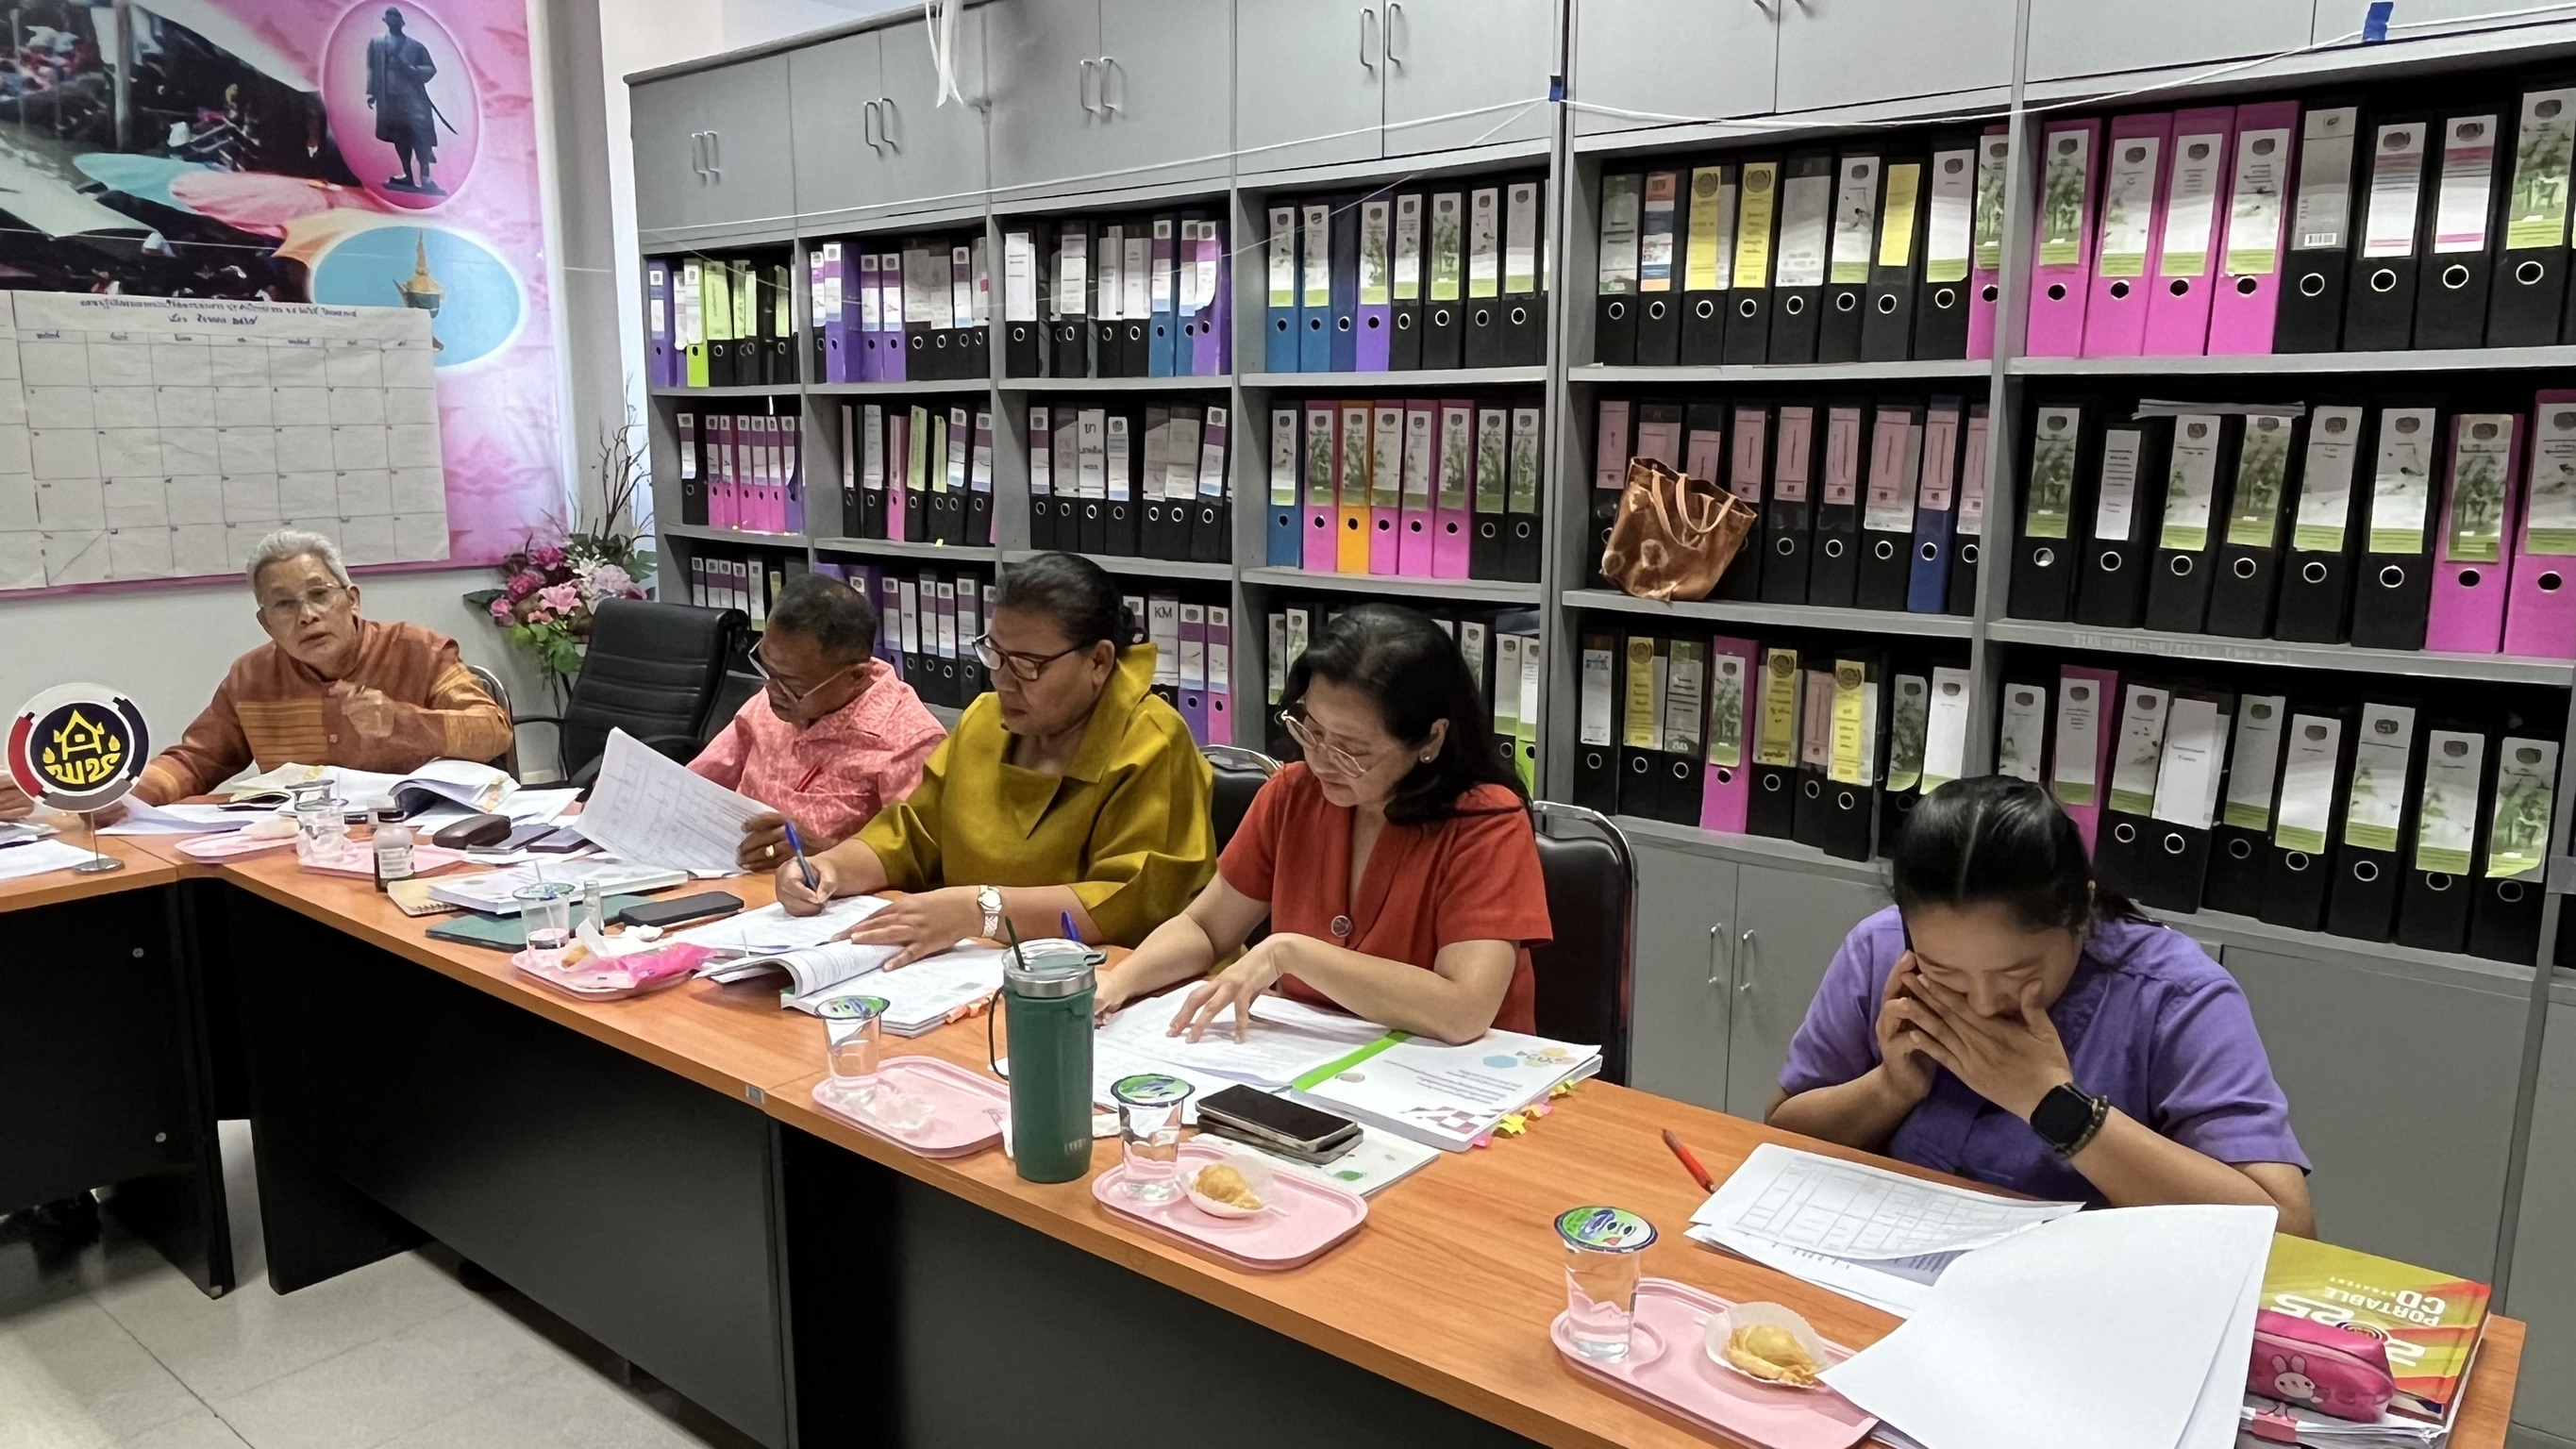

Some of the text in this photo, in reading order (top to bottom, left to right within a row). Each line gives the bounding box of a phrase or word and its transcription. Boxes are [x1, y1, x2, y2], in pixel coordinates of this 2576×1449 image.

[1154, 607, 1173, 619] KM
[2320, 1287, 2440, 1327] PORTABLE
[2396, 1290, 2446, 1315] CD
